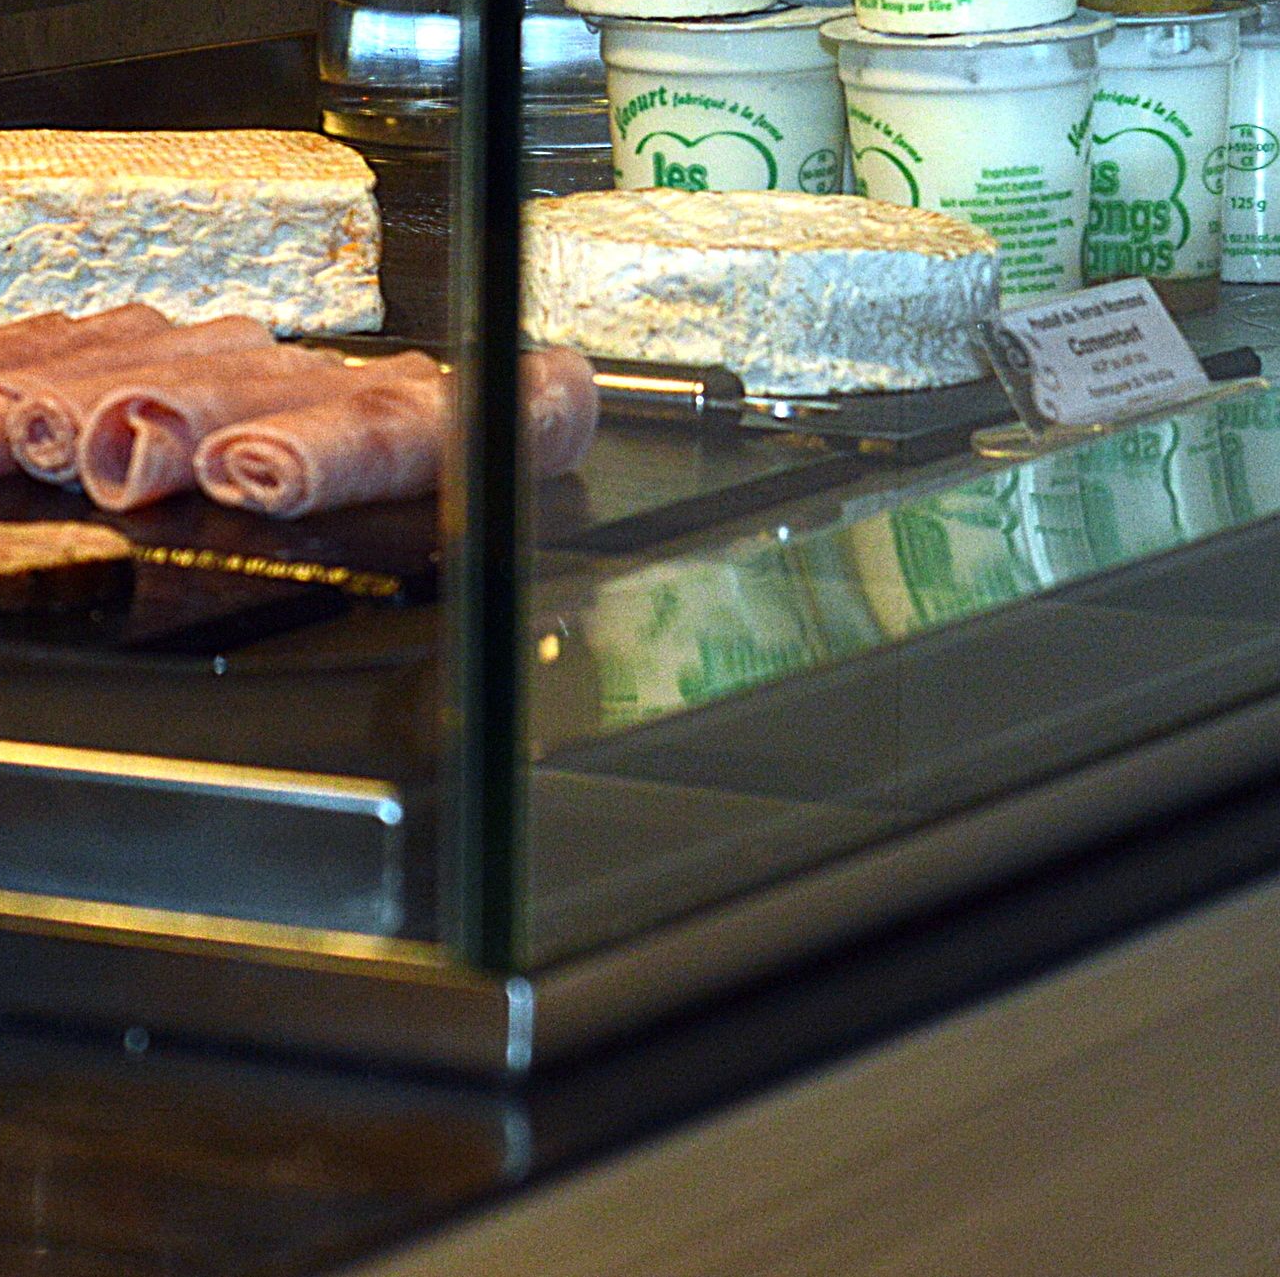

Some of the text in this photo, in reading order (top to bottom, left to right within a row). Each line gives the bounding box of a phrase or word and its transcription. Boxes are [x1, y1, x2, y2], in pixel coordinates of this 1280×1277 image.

[1231, 197, 1267, 212] 125 g
[1089, 200, 1171, 244] ongs
